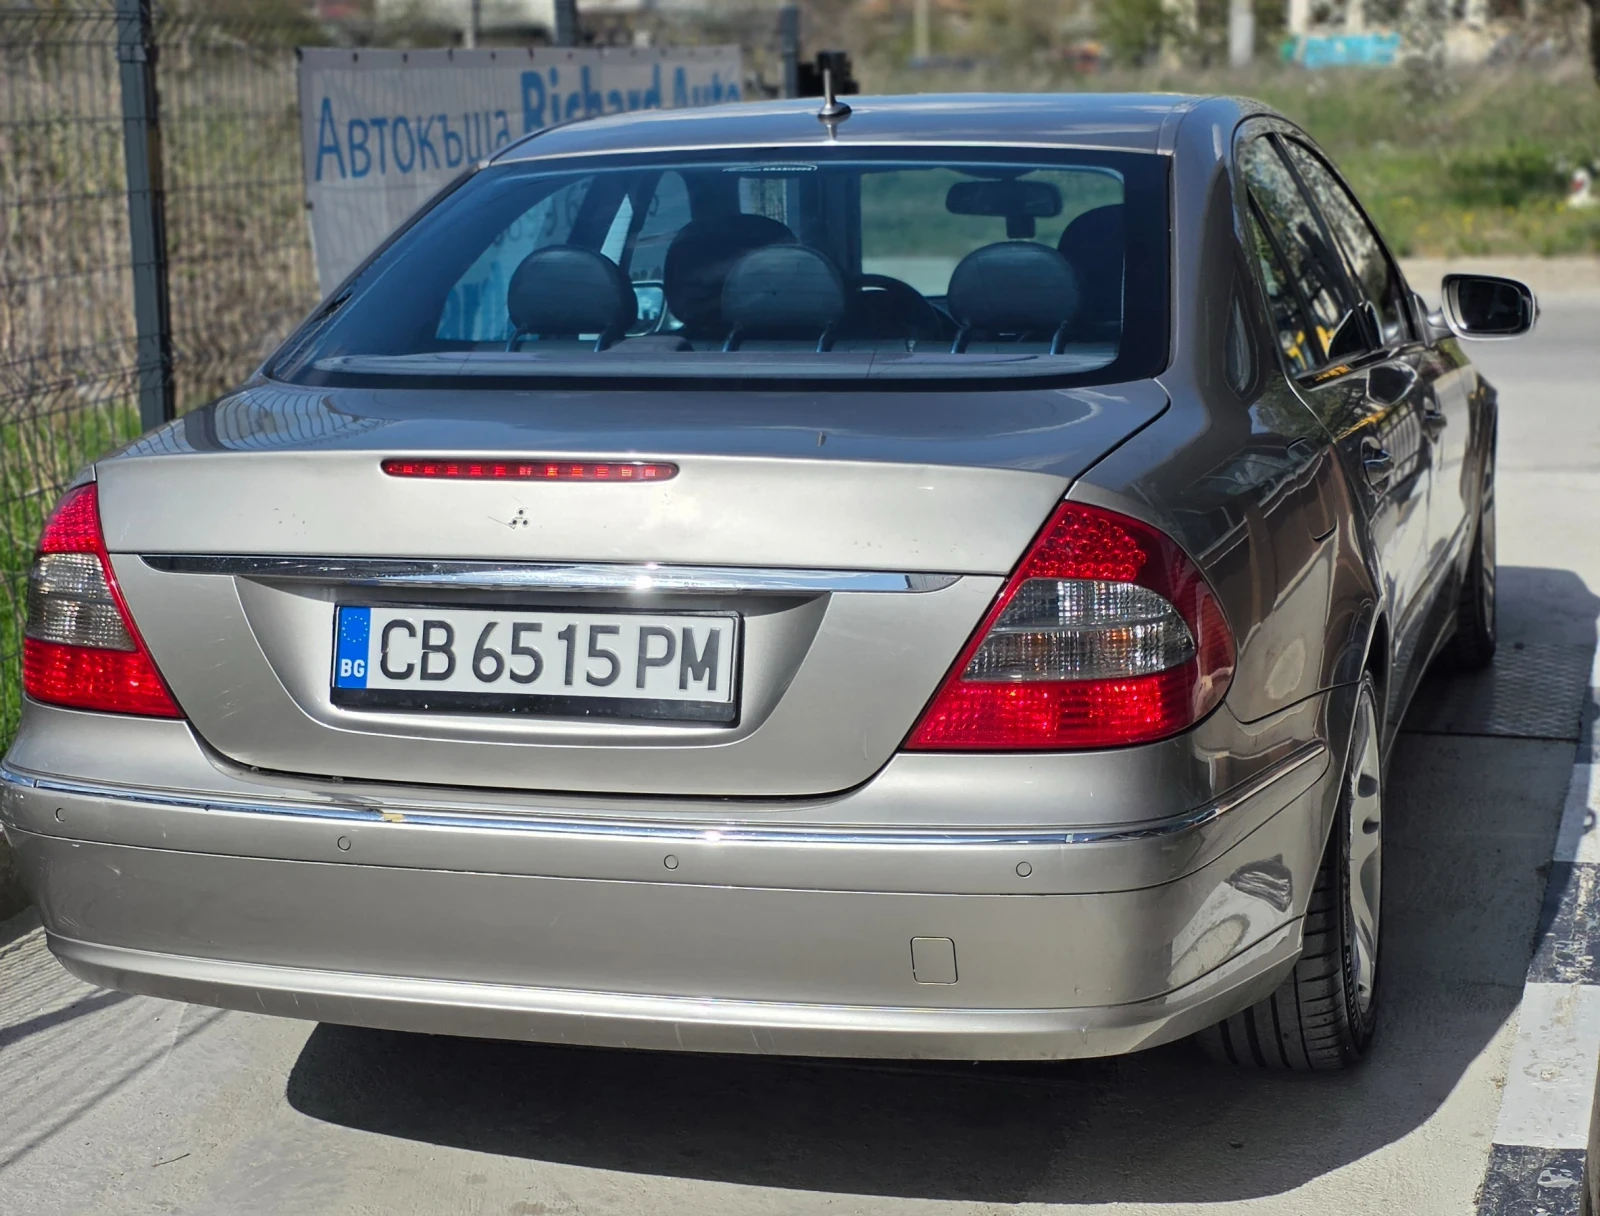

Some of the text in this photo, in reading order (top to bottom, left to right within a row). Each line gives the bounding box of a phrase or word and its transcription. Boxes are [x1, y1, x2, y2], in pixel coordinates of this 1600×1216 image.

[340, 658, 366, 678] BG
[380, 618, 722, 691] CB 6515 PM
